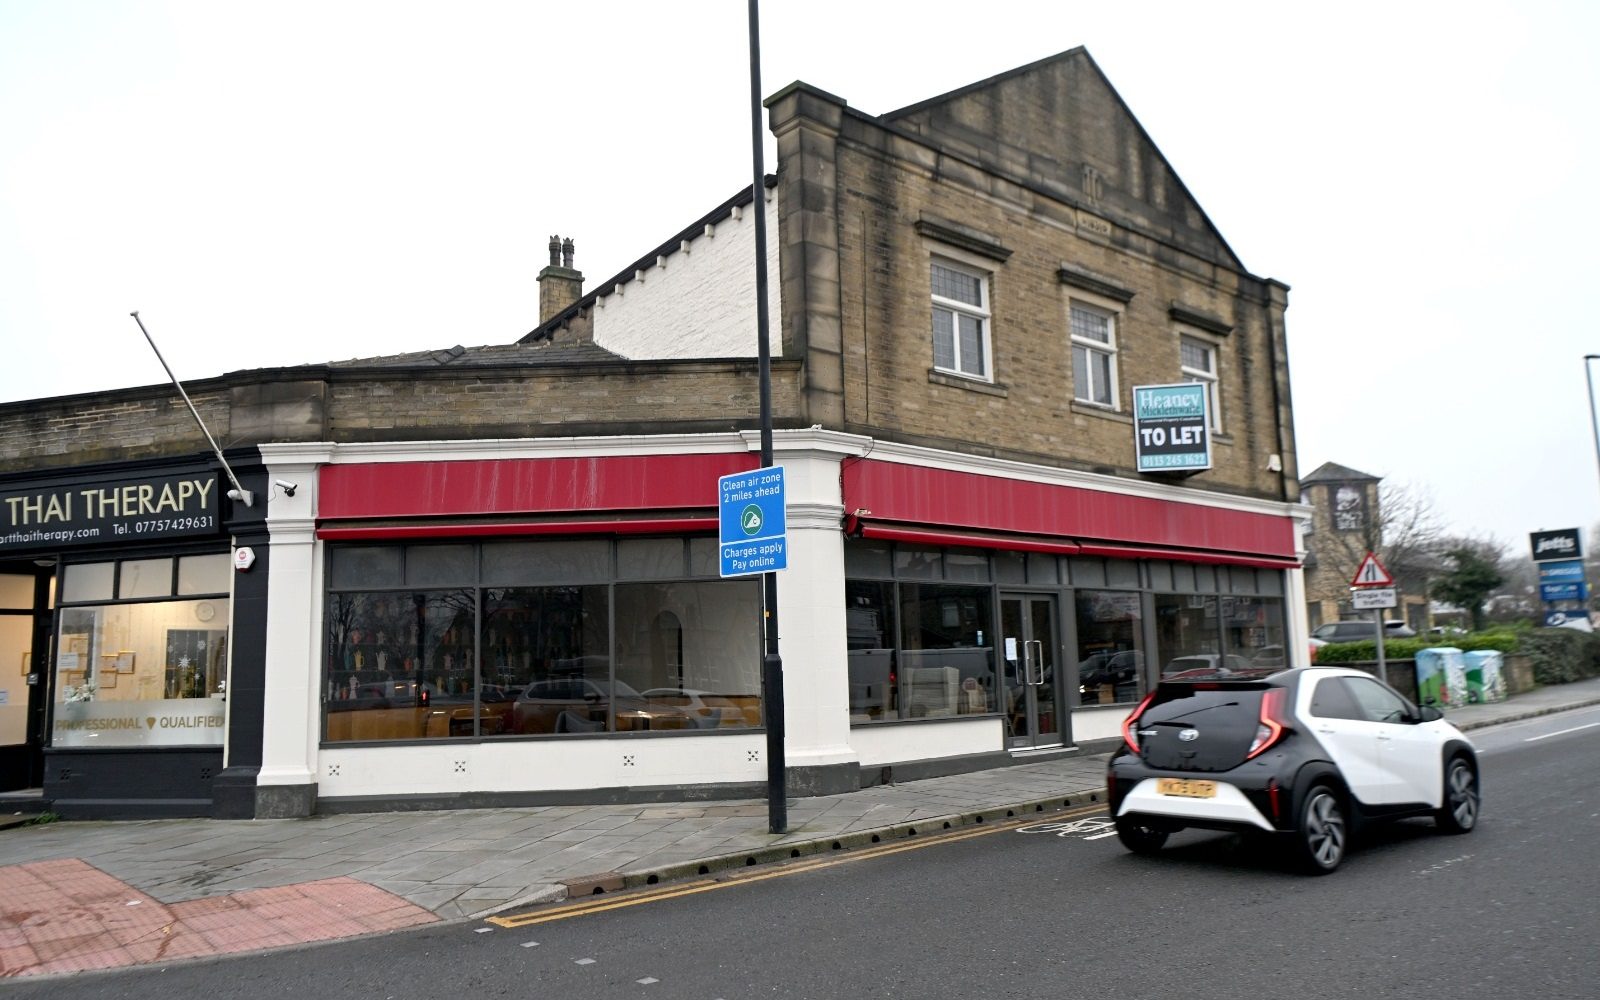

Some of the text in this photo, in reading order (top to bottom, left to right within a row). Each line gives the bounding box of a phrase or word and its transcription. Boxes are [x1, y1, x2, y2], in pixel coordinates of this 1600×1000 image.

[1140, 390, 1200, 408] Heaney
[1140, 425, 1203, 447] TO LET
[1143, 455, 1164, 467] 0113
[1166, 454, 1182, 466] 245
[722, 473, 781, 491] Clean air zone
[5, 478, 215, 526] THAI THERAPY
[724, 485, 780, 503] 2 miles ahead
[113, 523, 132, 535] Tel.
[135, 515, 214, 534] 07757429631
[724, 542, 783, 560] Charges apply
[732, 556, 775, 571] Pay online
[55, 715, 225, 732] PROFESSIONAL QUALIFIED
